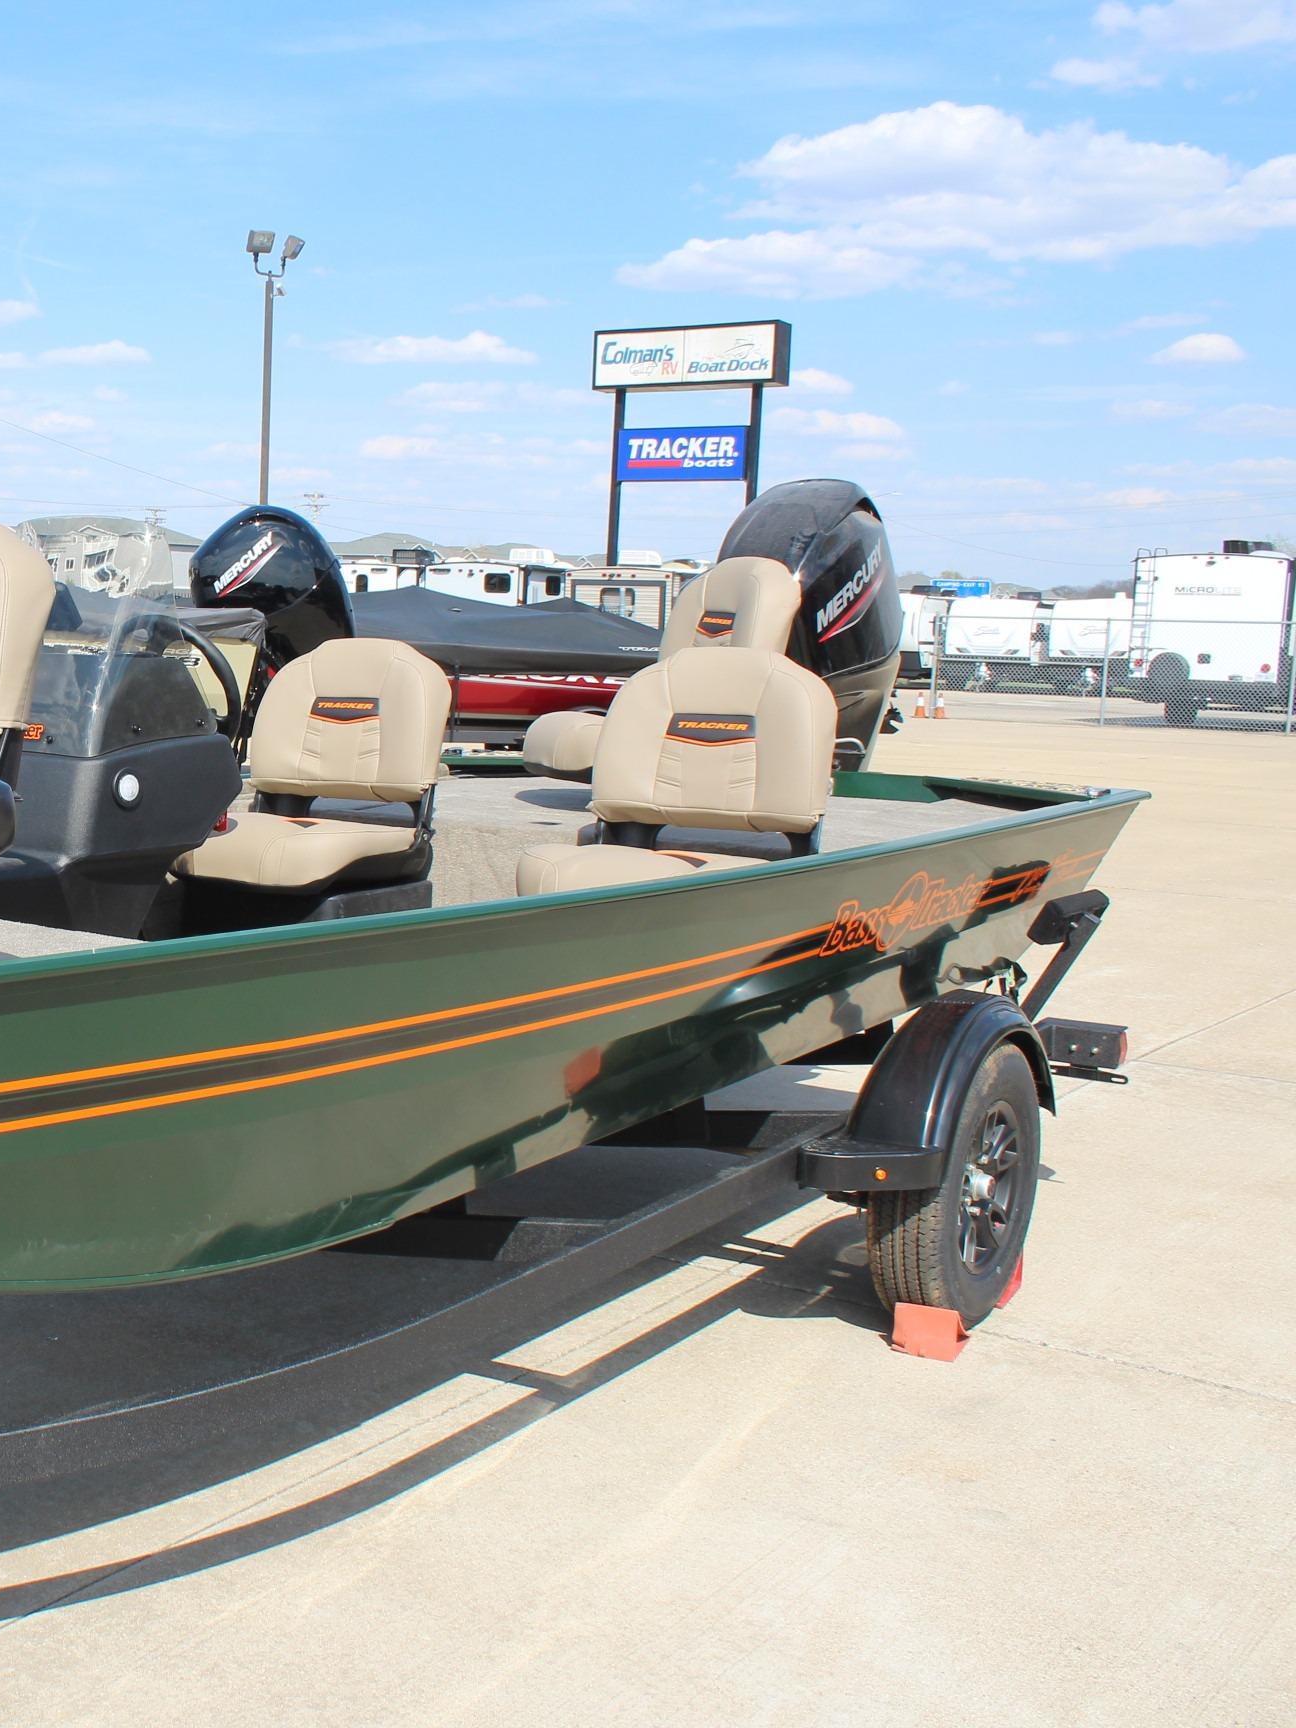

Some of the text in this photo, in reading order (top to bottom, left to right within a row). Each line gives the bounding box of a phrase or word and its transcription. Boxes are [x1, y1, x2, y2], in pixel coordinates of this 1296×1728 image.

[601, 342, 675, 365] Colman's
[661, 361, 679, 376] RV
[628, 436, 736, 459] TRACKER
[683, 458, 734, 468] boats
[213, 531, 273, 593] MERCURY
[816, 538, 883, 633] MERCURY
[317, 701, 374, 710] TRACKER
[677, 721, 749, 731] TRACKER
